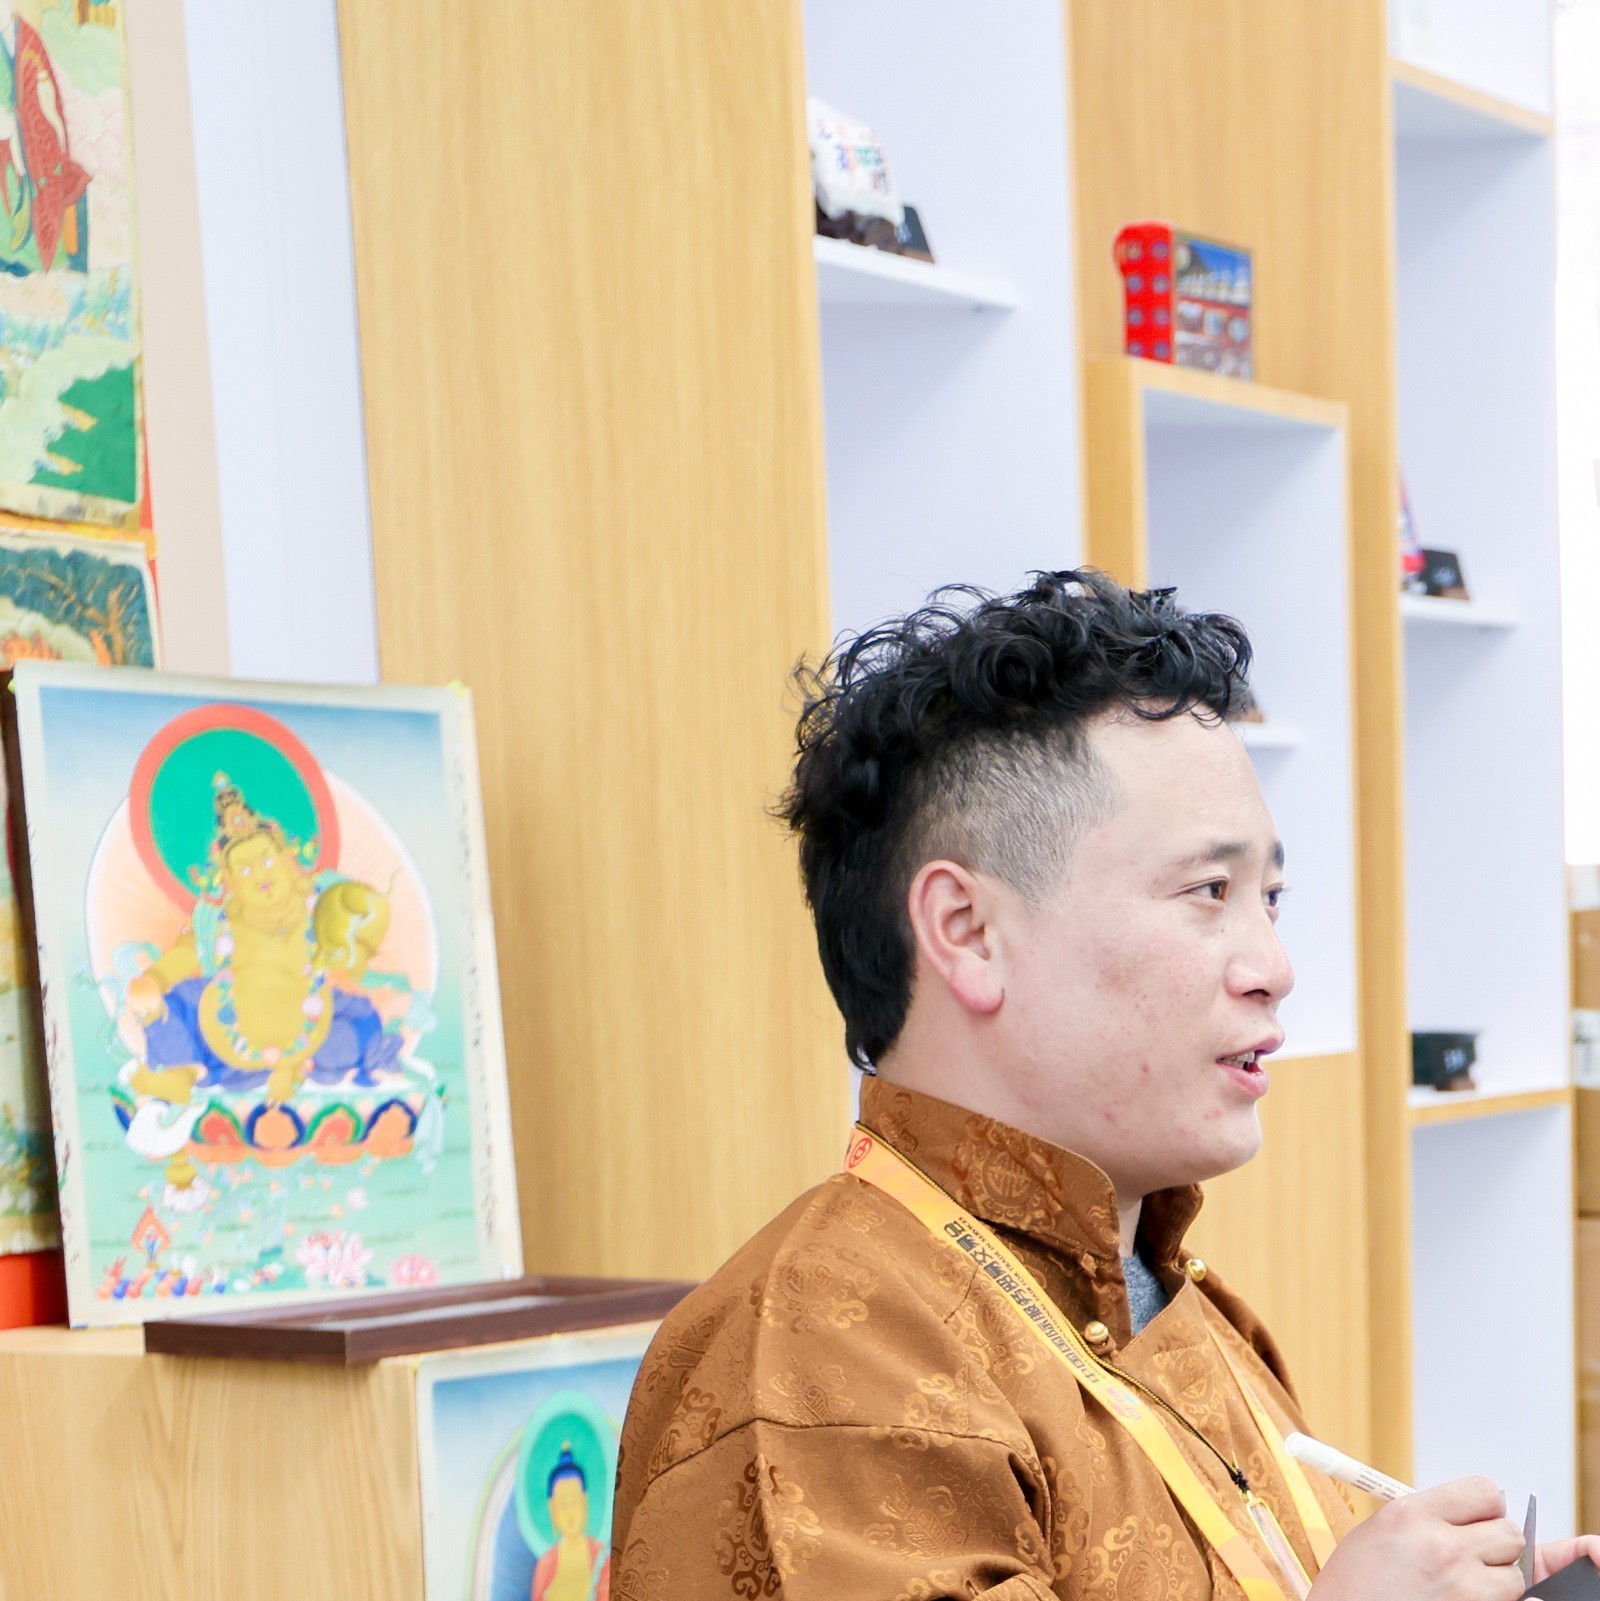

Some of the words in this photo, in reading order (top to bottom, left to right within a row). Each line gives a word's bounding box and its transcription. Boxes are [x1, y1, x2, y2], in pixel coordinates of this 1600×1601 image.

[958, 1216, 986, 1242] SERVICES
[985, 1241, 994, 1251] IN
[992, 1249, 1014, 1272] TRADE
[1012, 1271, 1027, 1287] FOR
[942, 1217, 1099, 1385] 中国国际服务贸易交易会
